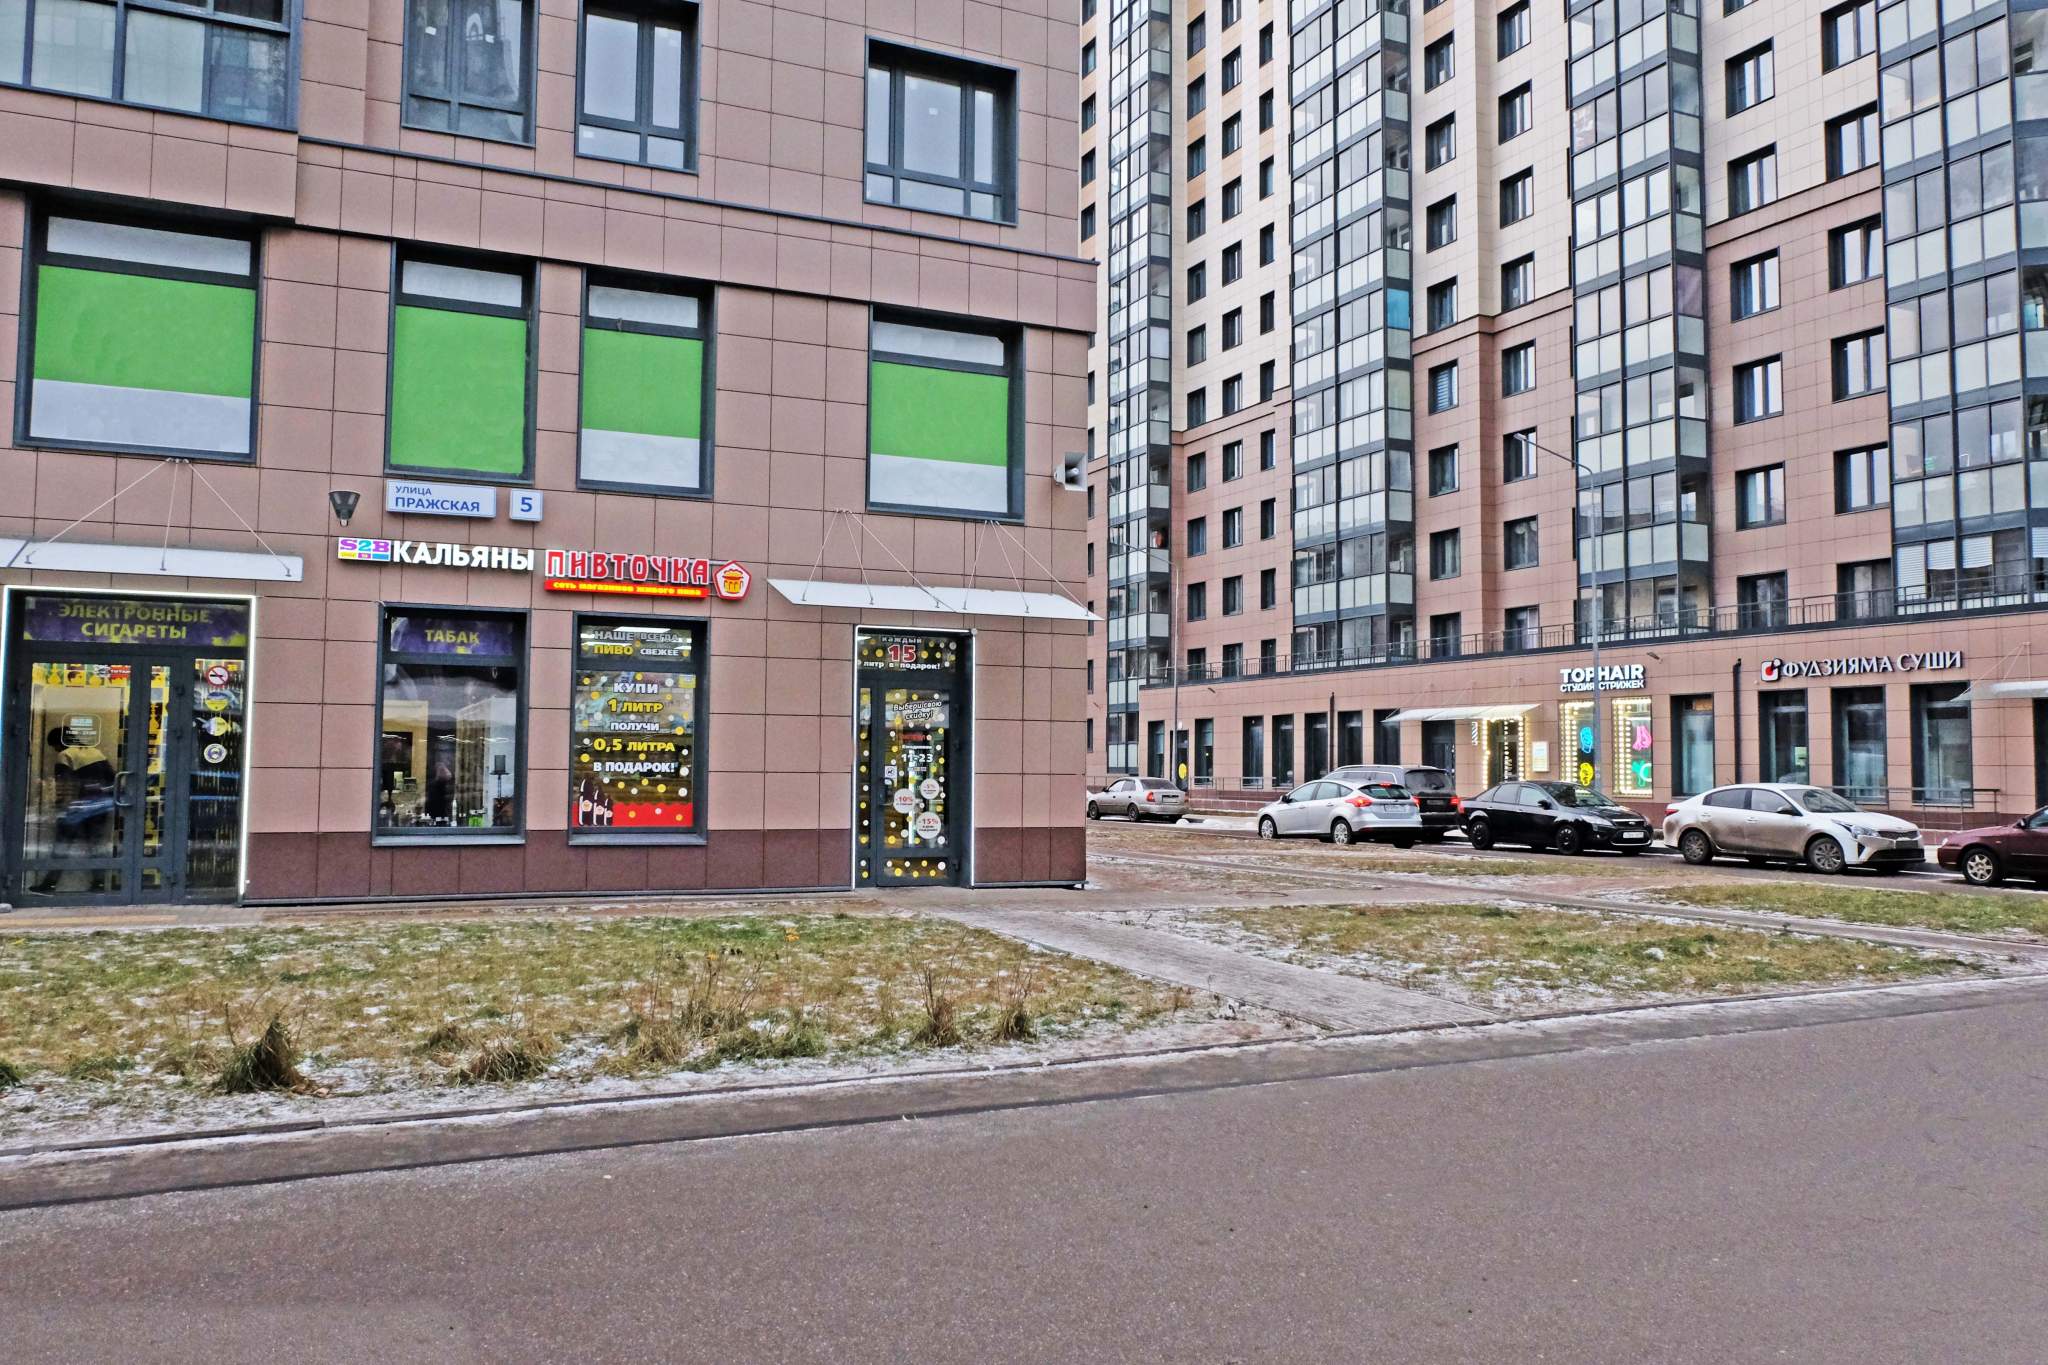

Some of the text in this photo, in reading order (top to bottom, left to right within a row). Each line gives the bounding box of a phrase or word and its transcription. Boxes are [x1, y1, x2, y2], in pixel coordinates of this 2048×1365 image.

[395, 486, 432, 496] УЛИЦА
[395, 497, 480, 512] ПРАЖСКАЯ
[520, 497, 533, 513] 5
[340, 538, 390, 553] S2B
[393, 540, 535, 571] КАЛЬЯНЫ
[545, 550, 711, 585] ПИВТОЧКА
[58, 604, 211, 624] ЭЛЕКТРОННЫЕ
[81, 622, 187, 639] СИГАРЕТЫ
[425, 629, 479, 644] ТАБАК
[594, 630, 634, 641] НАШЕ
[640, 632, 679, 642] ВСЕГДА
[593, 644, 634, 655] ПИВО
[640, 648, 680, 656] СВЕЖЕЕ
[888, 644, 917, 662] 15
[1782, 650, 1963, 678] ФУДЗИЯМА СУШИ
[613, 683, 659, 694] КУПИ
[1559, 680, 1645, 692] СТУДИЯ СТРИЖЕК
[607, 698, 664, 713] 1 ЛИТР
[610, 722, 660, 731] ПОЛУЧИ
[593, 738, 676, 752] 0,5 ЛИТРА
[901, 753, 934, 763] 11-23
[593, 762, 676, 774] В ПОДАРОК!
